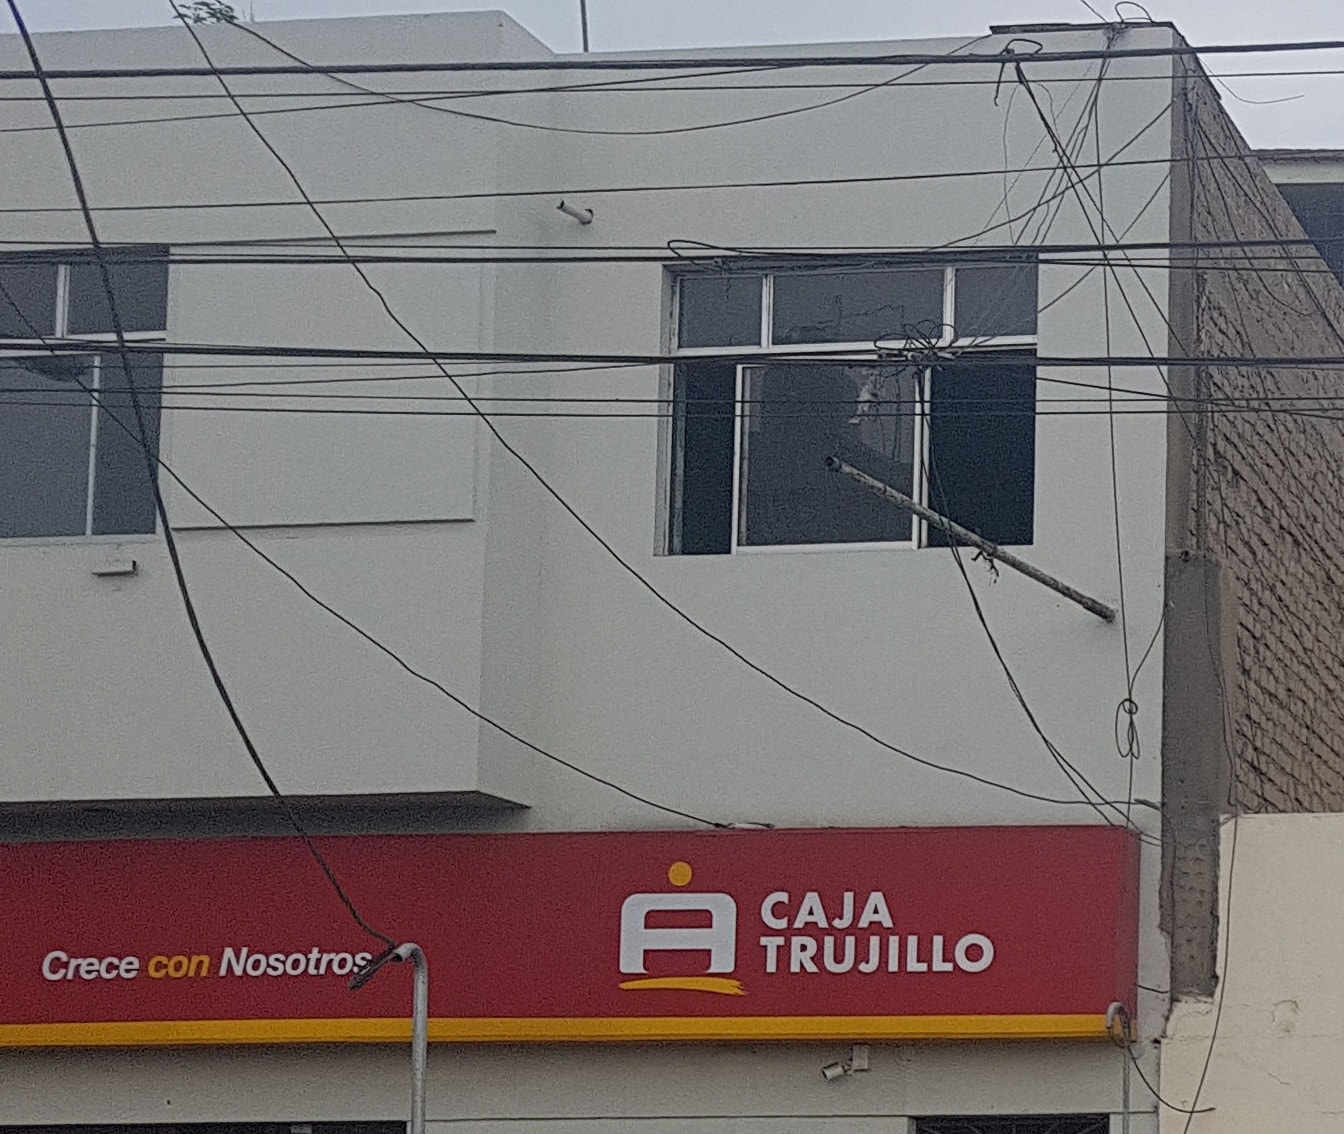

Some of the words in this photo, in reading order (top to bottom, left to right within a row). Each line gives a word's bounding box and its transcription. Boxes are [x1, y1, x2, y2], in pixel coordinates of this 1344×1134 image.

[760, 890, 895, 931] CAJA
[42, 950, 141, 981] Crece
[148, 954, 211, 979] con
[218, 946, 373, 977] Nosotros
[759, 932, 995, 974] TRUJILLO
